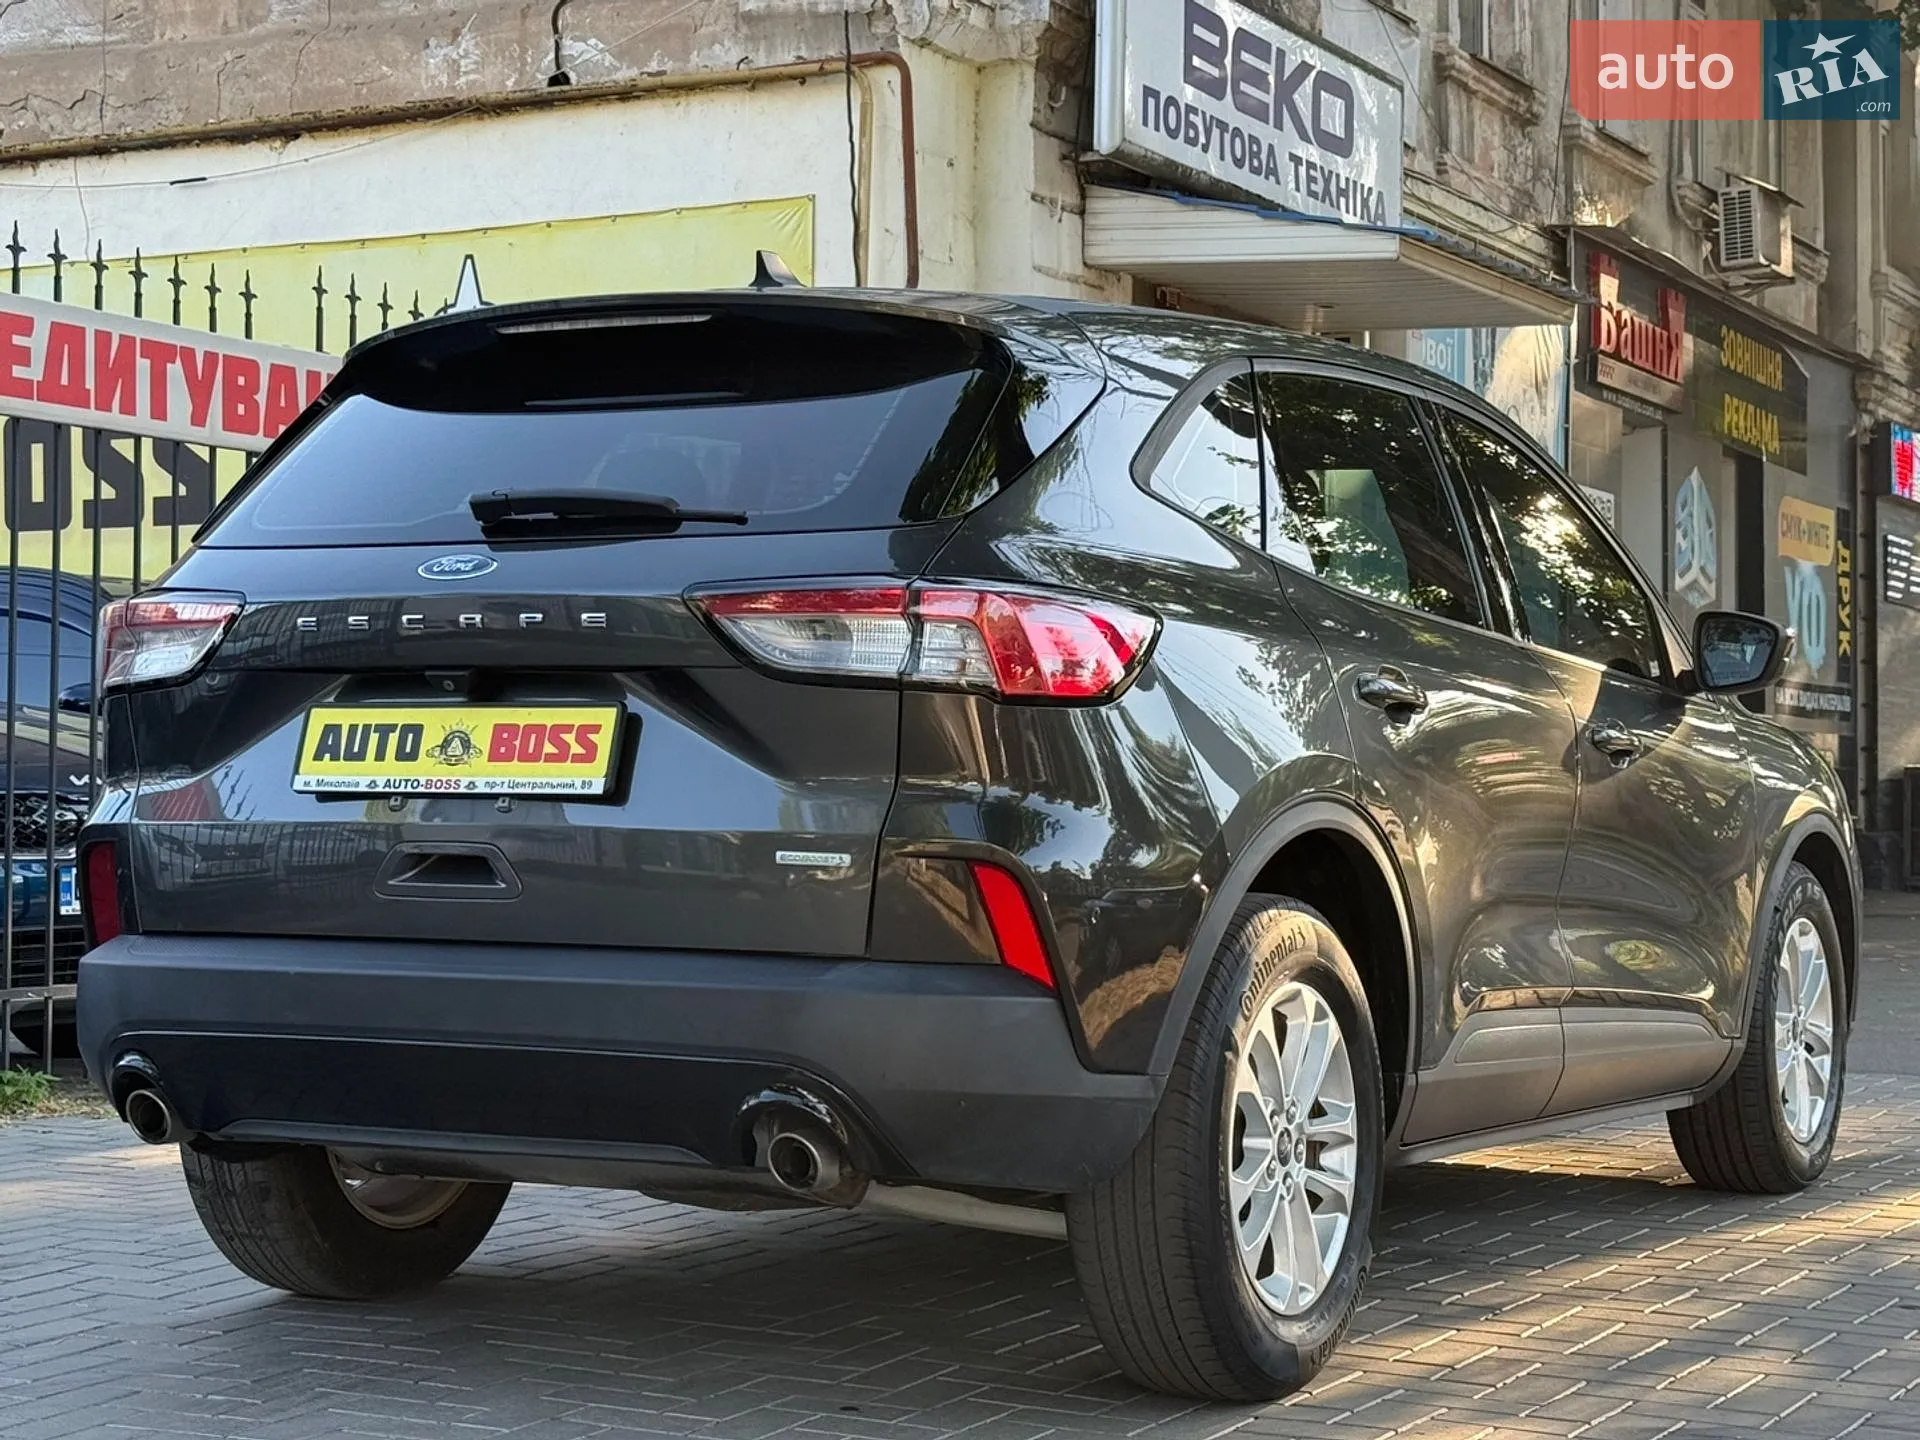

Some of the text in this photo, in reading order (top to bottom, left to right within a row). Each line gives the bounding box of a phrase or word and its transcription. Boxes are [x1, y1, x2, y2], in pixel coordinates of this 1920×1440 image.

[1184, 0, 1354, 159] BEKO
[1142, 85, 1387, 227] ПОБУТОВА ТЕХНІКА
[1721, 324, 1783, 392] ЗОВНІШНЯ
[1723, 392, 1780, 456] РЕКЛАМА
[432, 557, 480, 573] Ford
[296, 612, 608, 633] ESCAPE
[1837, 540, 1851, 658] ДРУК
[312, 723, 602, 764] AUTO BOSS
[382, 778, 462, 790] AUTO-BOSS
[580, 780, 593, 790] 89
[1240, 928, 1299, 1022] Continental
